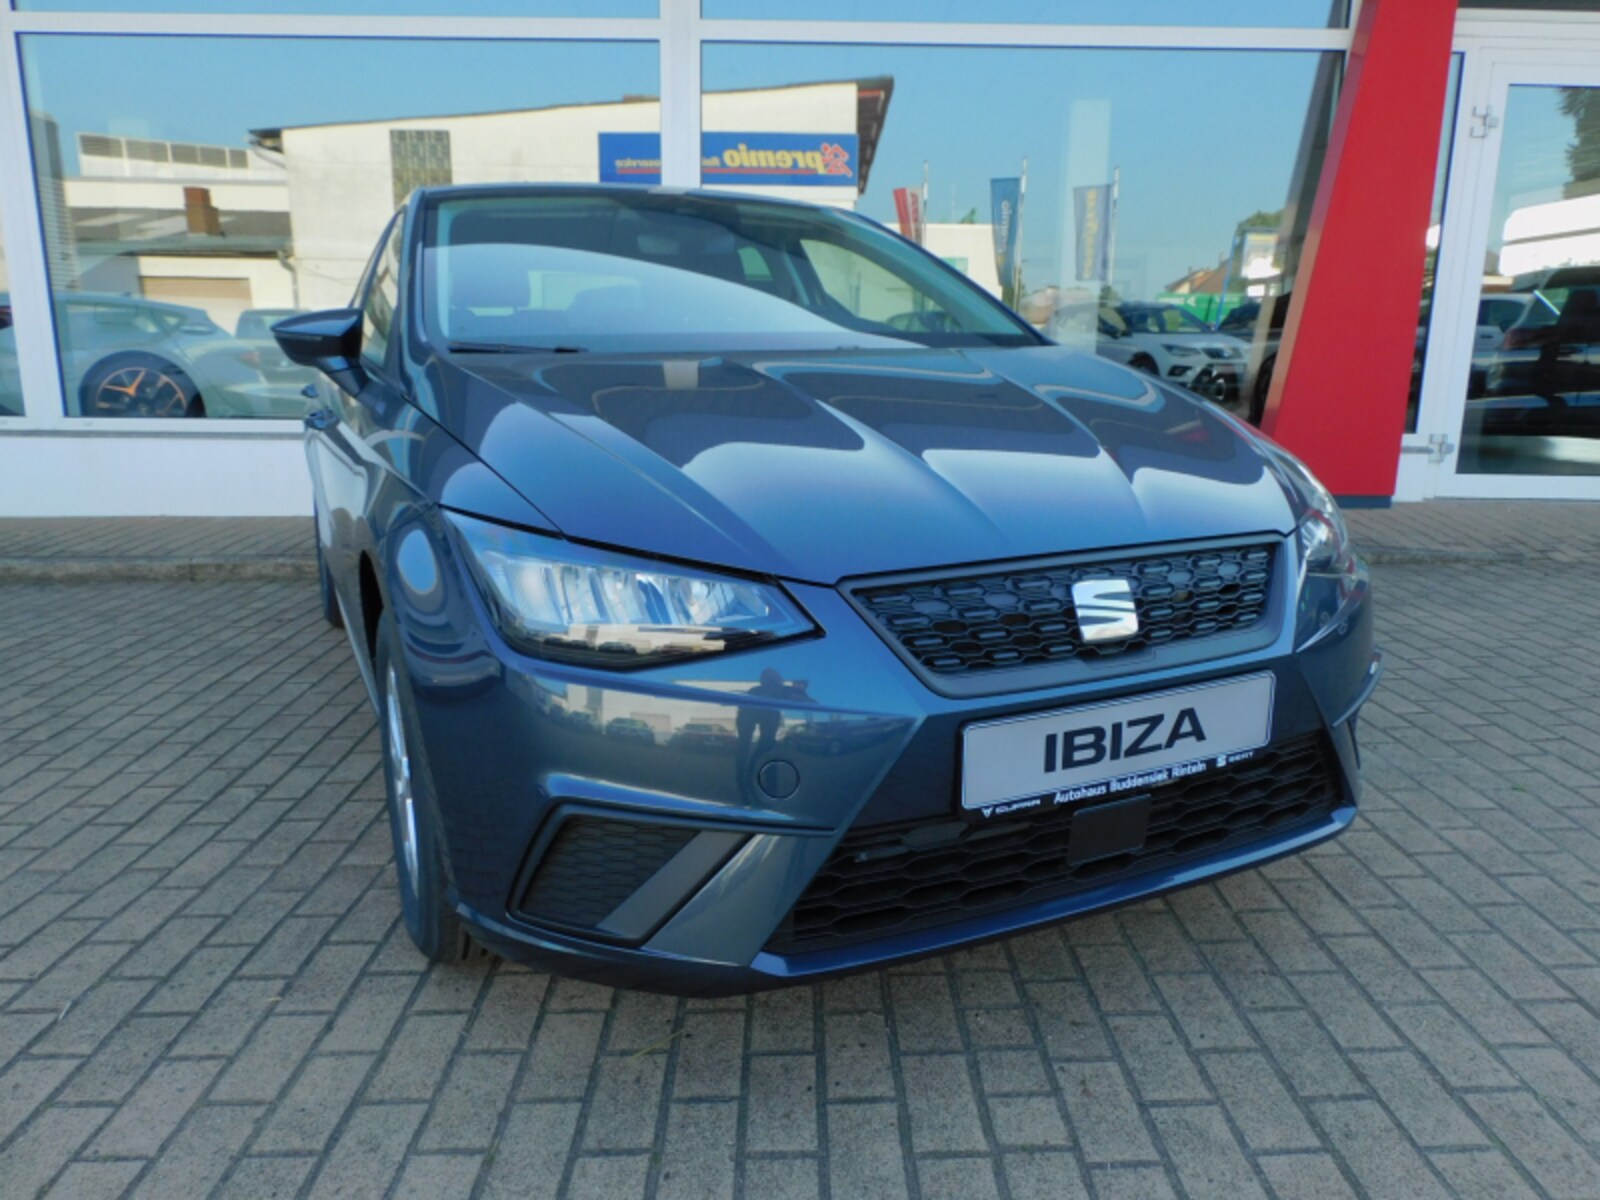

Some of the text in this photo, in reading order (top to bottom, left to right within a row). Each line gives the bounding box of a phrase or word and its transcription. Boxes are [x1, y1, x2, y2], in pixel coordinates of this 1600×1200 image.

[1044, 707, 1206, 773] IBIZA
[1054, 785, 1106, 804] Autohaus
[1172, 761, 1206, 777] Rinteln
